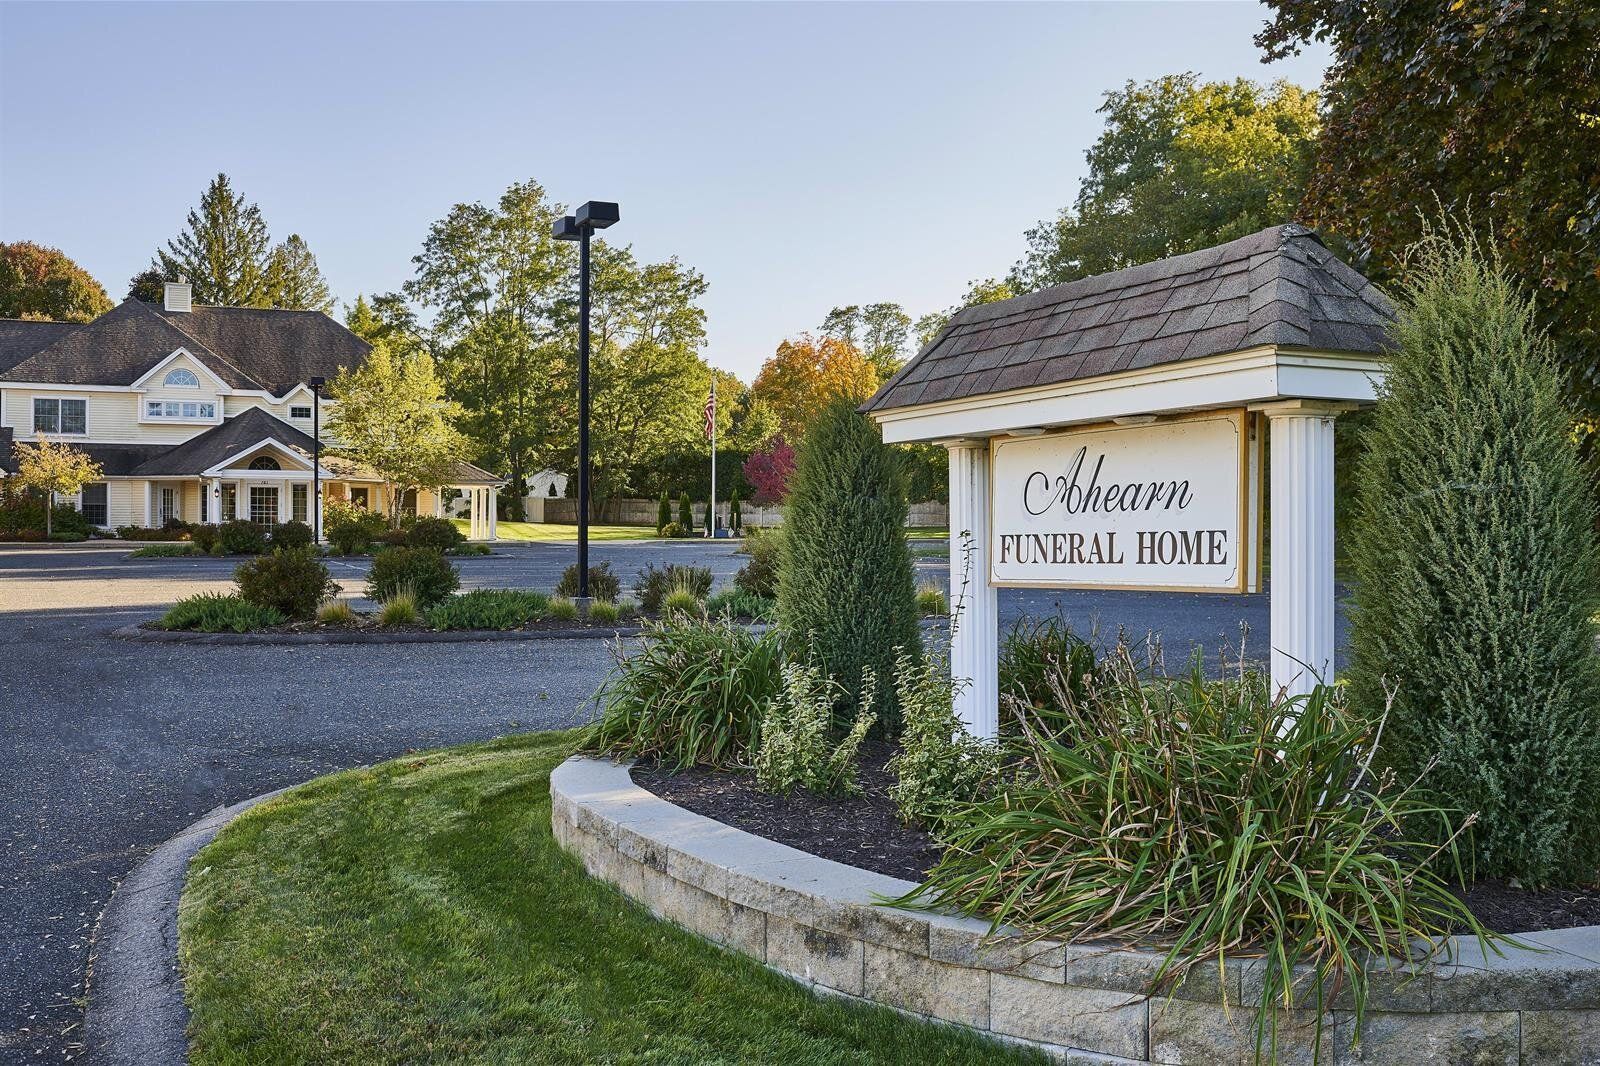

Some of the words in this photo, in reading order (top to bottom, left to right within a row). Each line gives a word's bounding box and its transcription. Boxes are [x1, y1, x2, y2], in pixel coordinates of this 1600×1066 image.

[1023, 446, 1194, 516] Ahearn
[1000, 532, 1124, 565] FUNERAL
[1136, 530, 1228, 565] HOME
